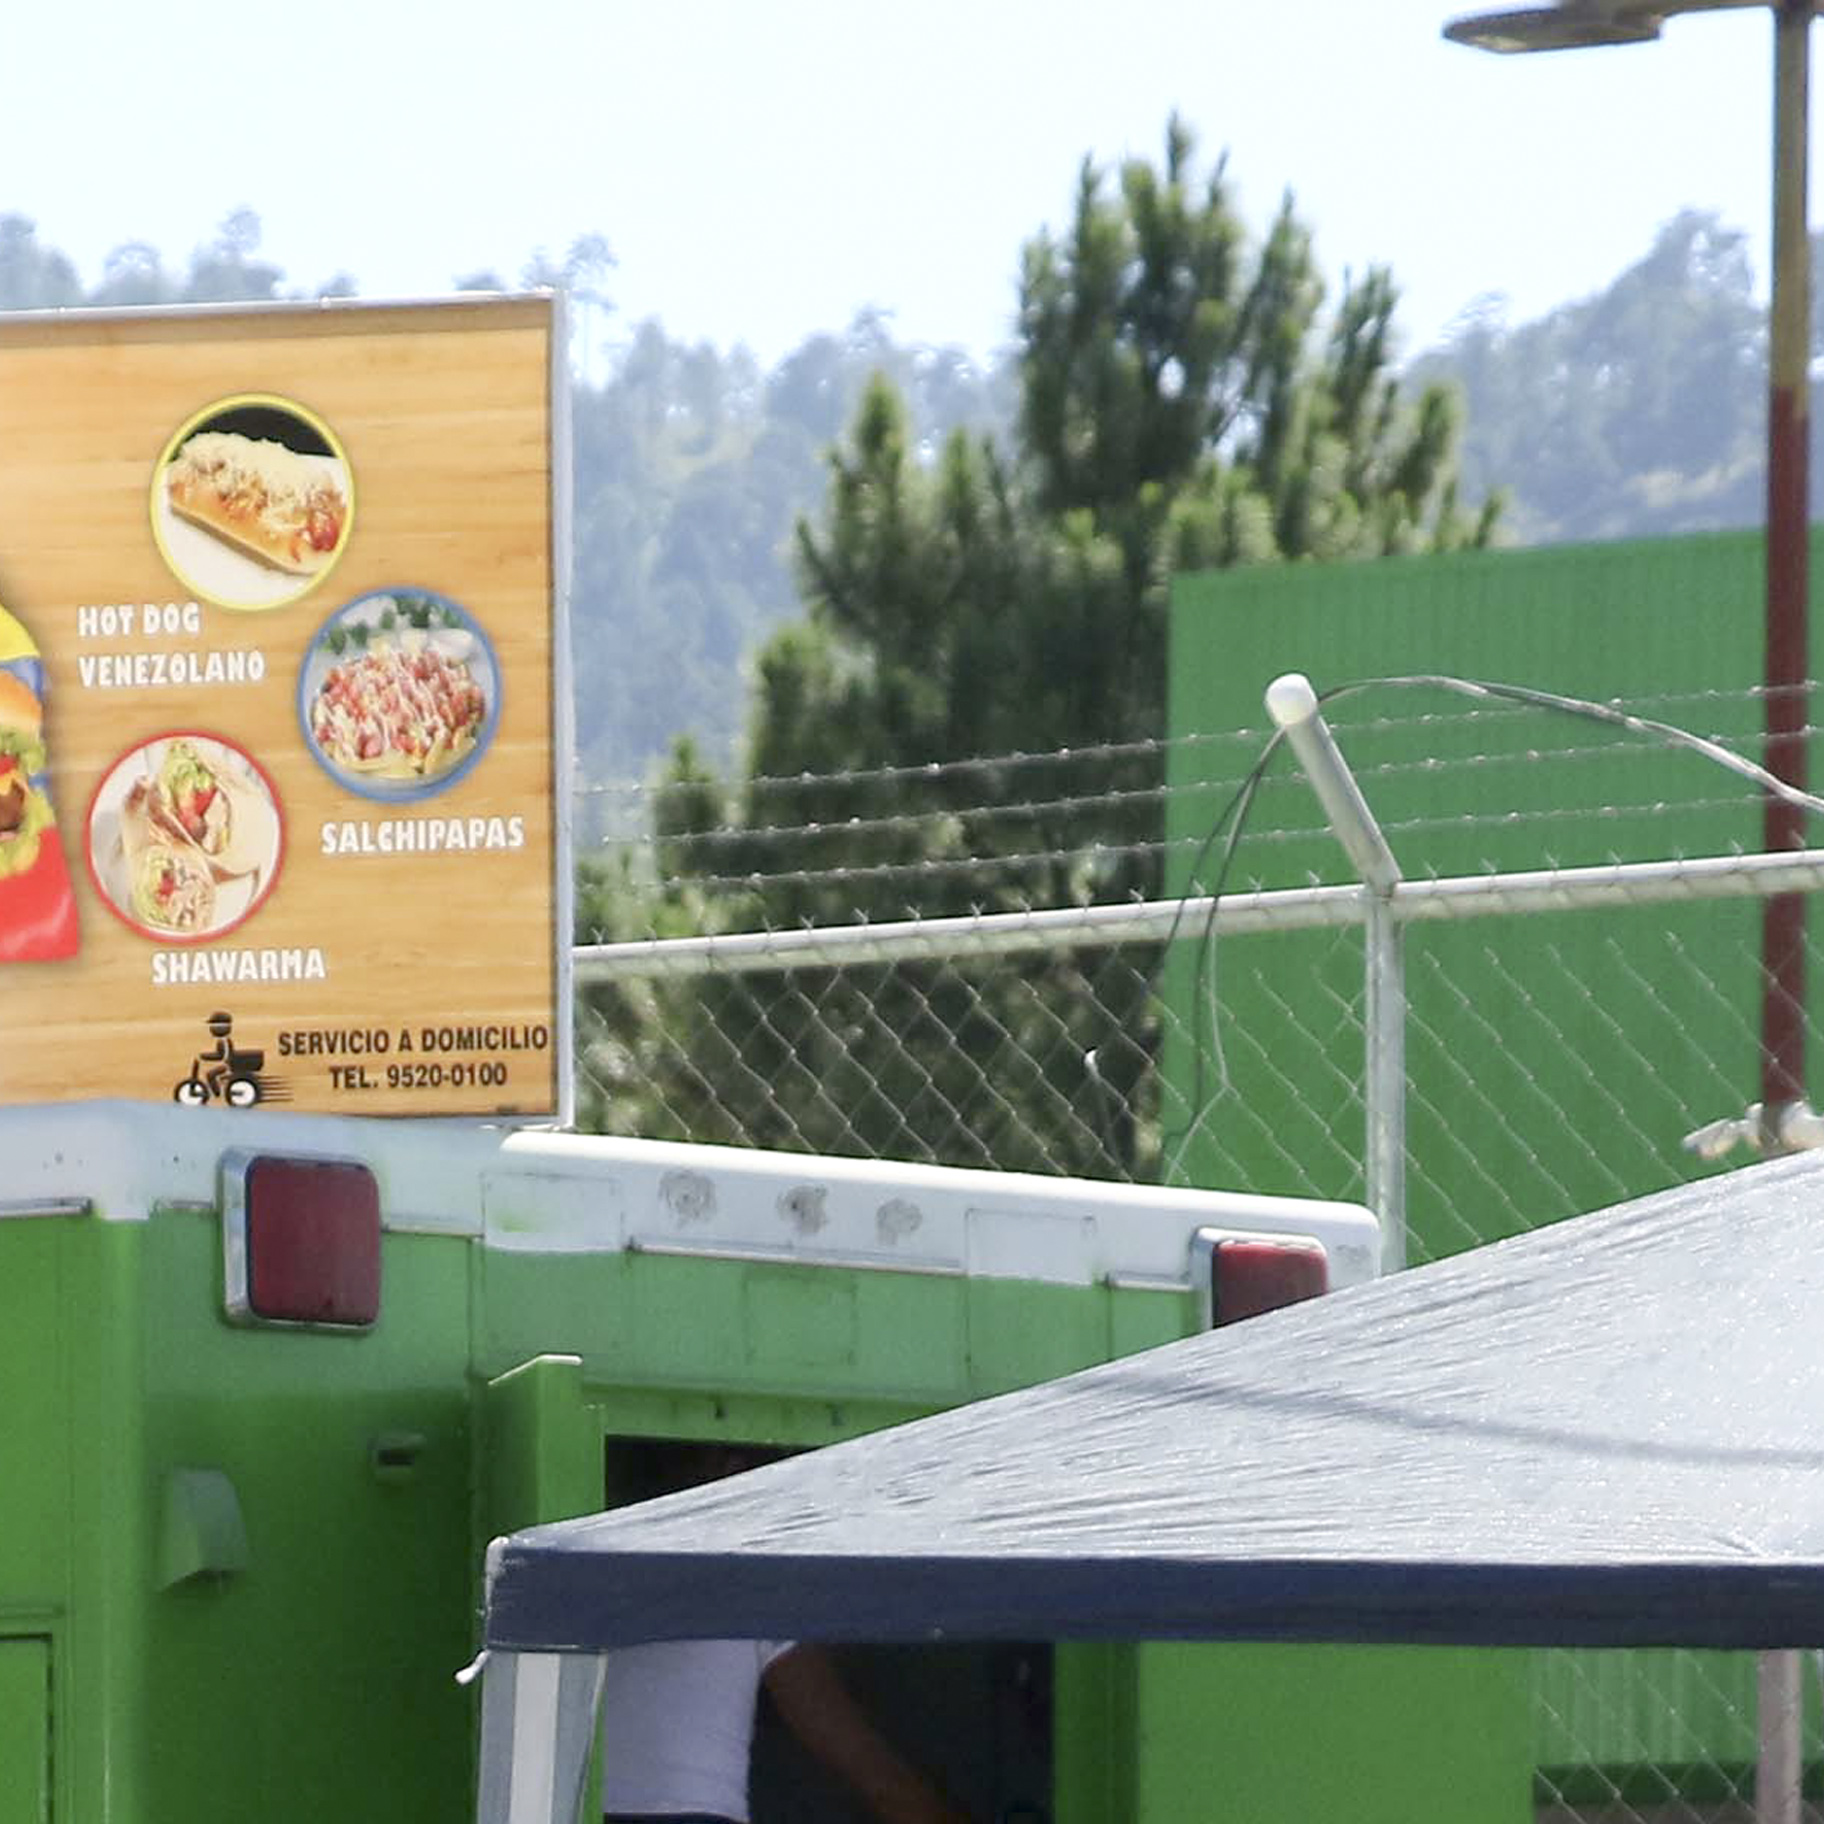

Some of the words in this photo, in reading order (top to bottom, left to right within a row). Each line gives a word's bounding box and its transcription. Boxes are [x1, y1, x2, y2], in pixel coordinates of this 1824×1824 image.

[79, 606, 133, 636] HOT
[143, 603, 200, 635] DOG
[79, 651, 265, 688] VENEZOLANO
[322, 817, 524, 854] SALCHIPAPAS
[152, 949, 326, 984] SHAWARMA
[278, 1029, 390, 1057] SERVICIO
[397, 1029, 414, 1053] A
[421, 1025, 549, 1053] DOMICILIO
[328, 1065, 380, 1091] TEL.
[386, 1061, 508, 1090] 9520-0100
